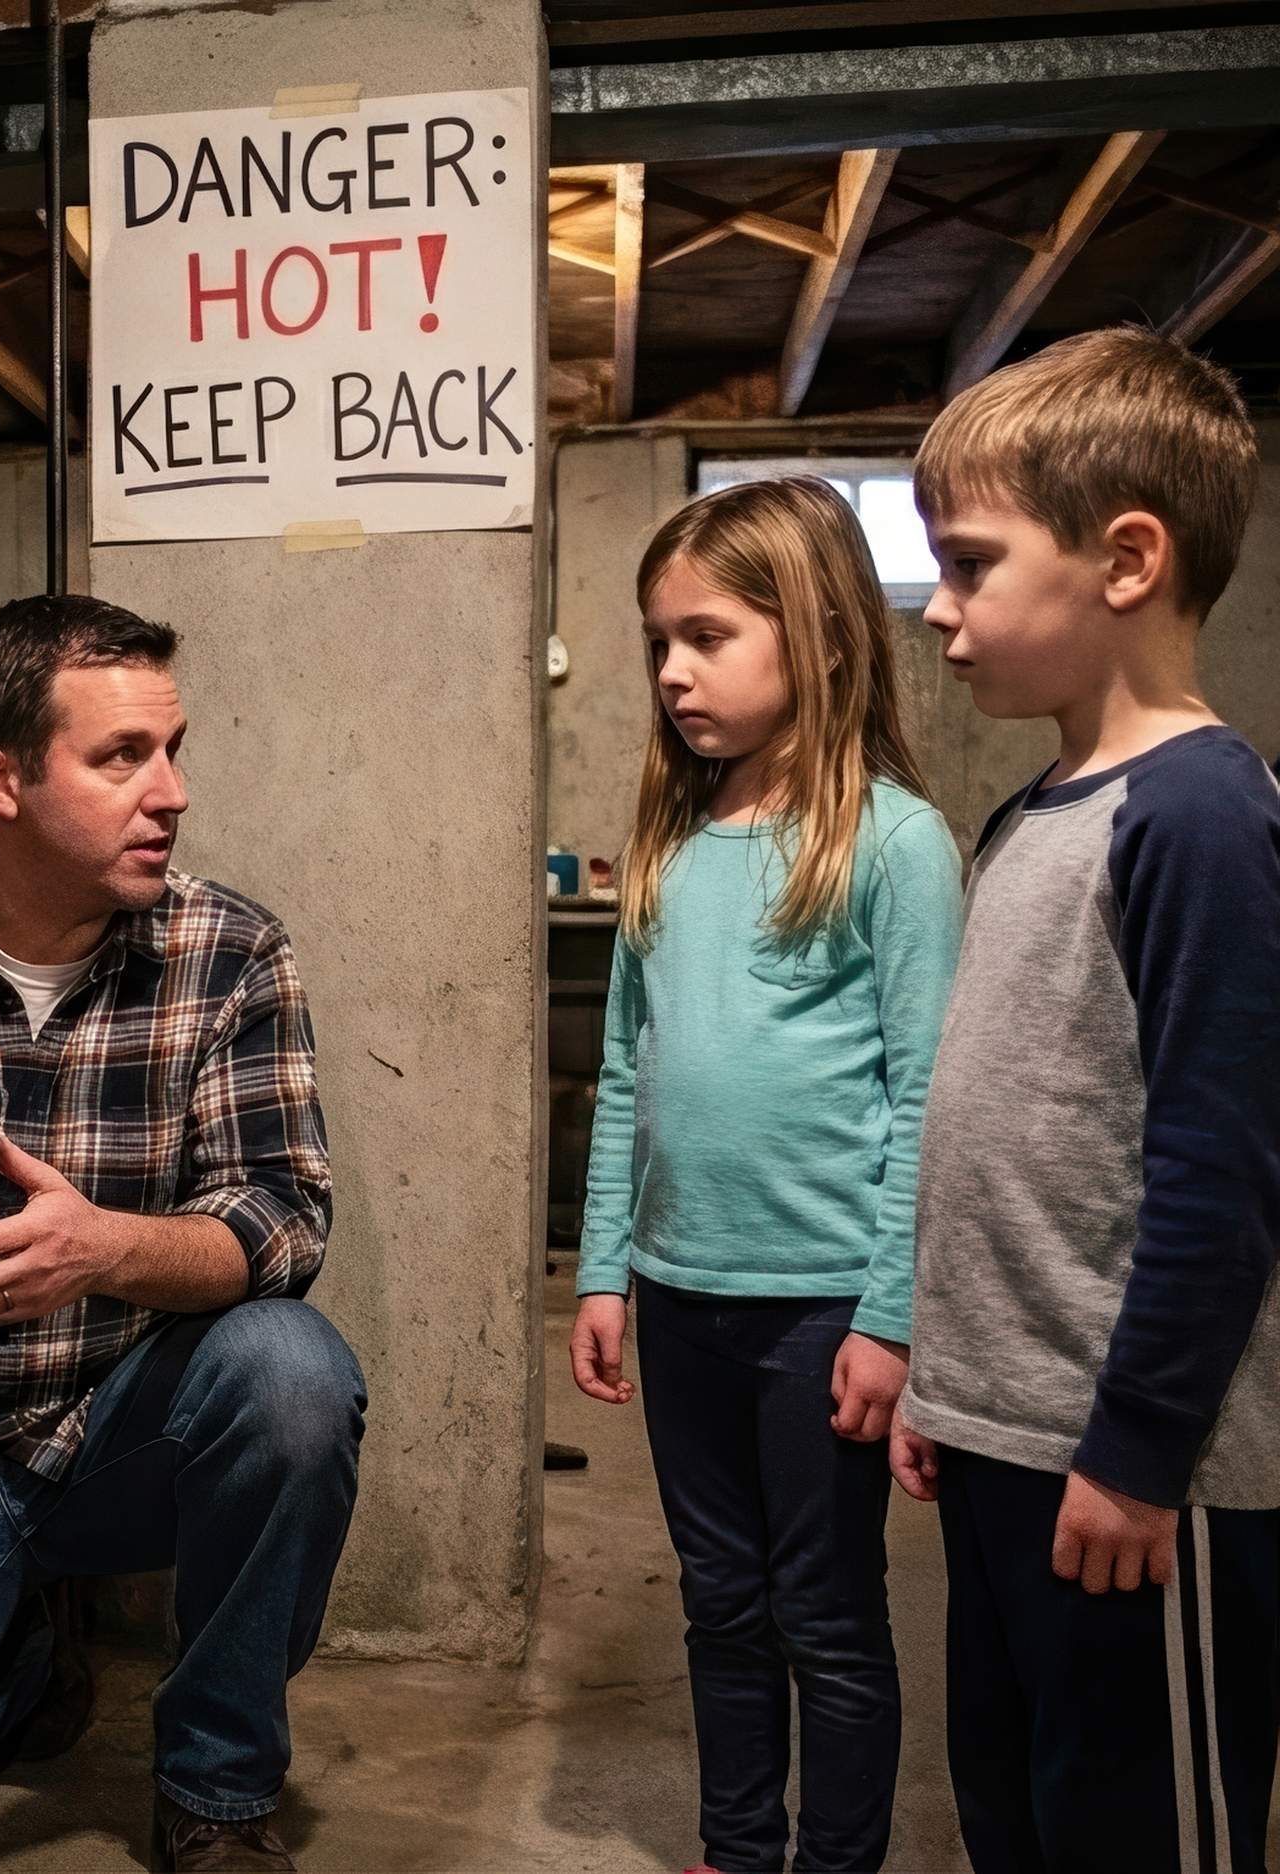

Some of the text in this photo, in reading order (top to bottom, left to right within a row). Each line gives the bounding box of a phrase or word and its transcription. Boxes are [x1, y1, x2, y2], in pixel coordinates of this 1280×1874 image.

[123, 116, 507, 229] DANGER:
[187, 233, 448, 342] HOT!
[112, 375, 296, 475] KEEP
